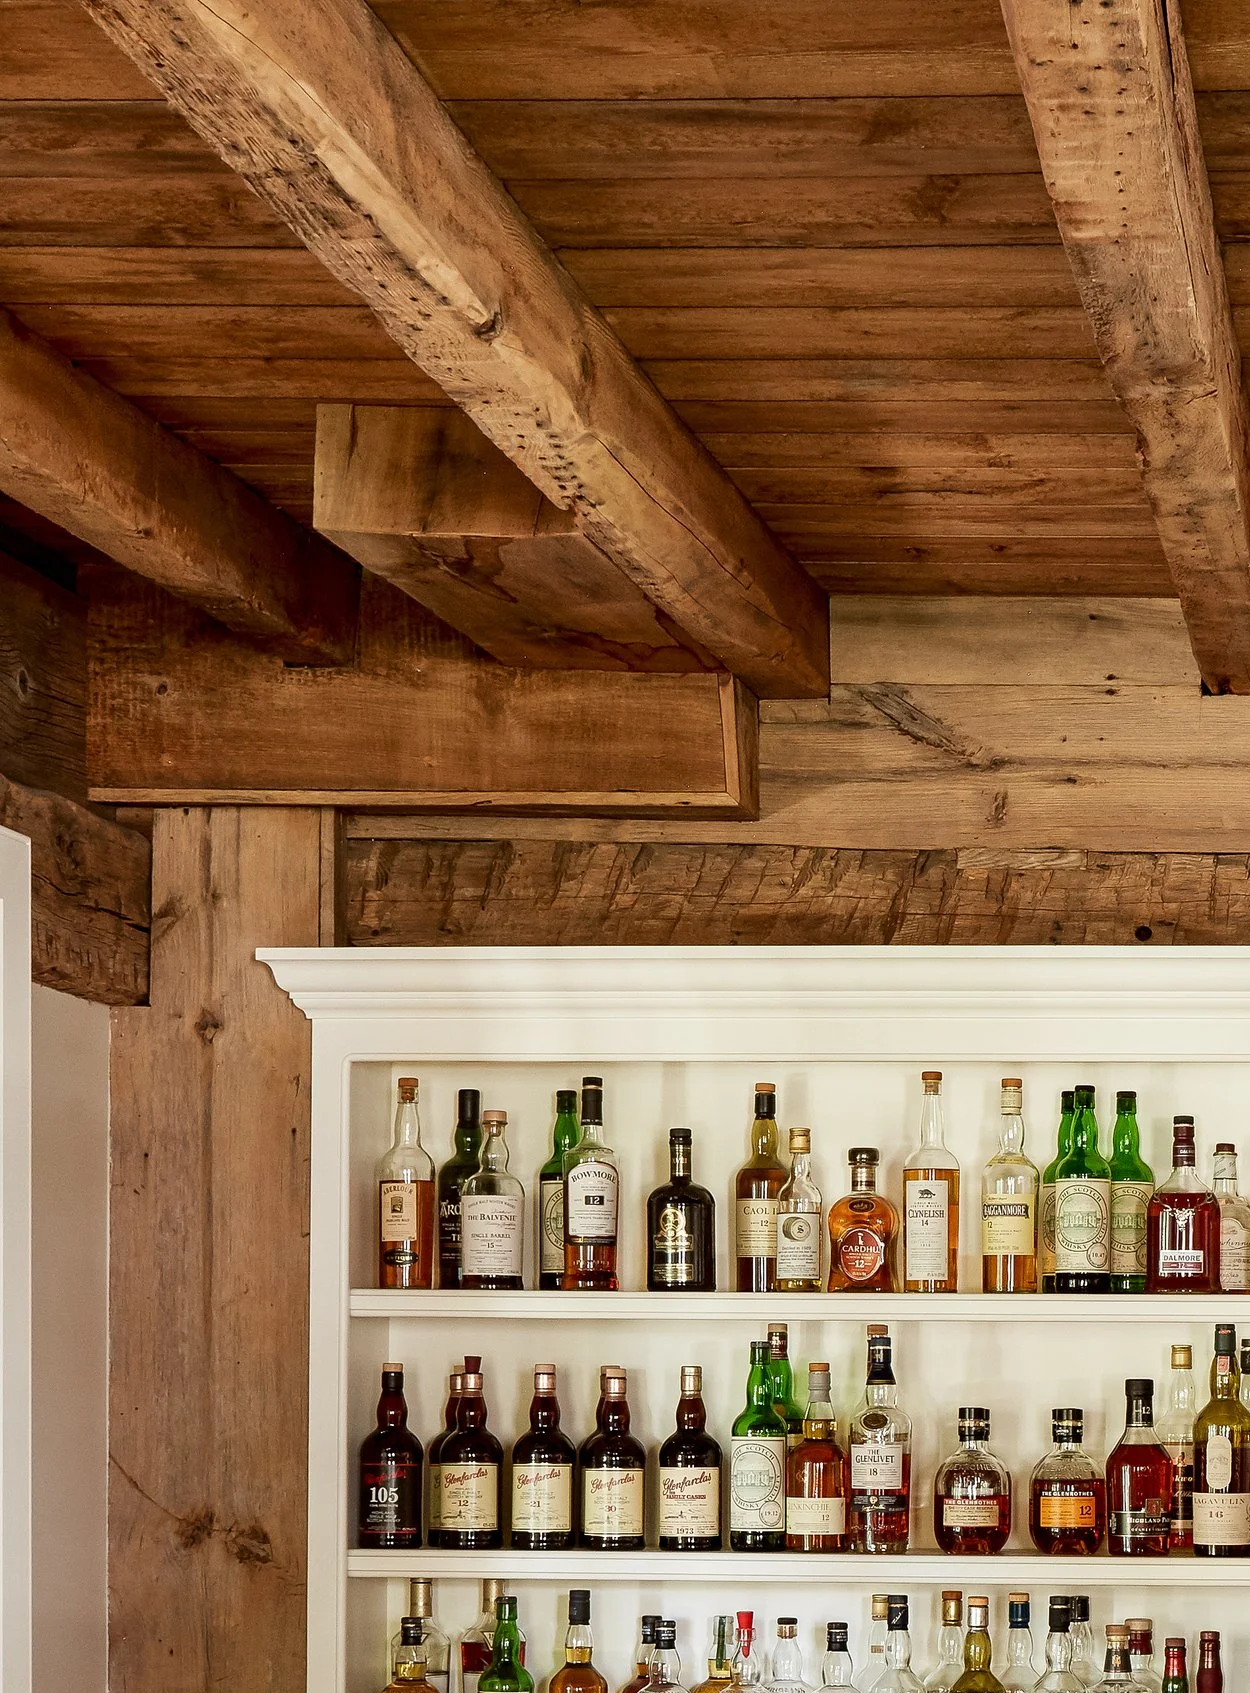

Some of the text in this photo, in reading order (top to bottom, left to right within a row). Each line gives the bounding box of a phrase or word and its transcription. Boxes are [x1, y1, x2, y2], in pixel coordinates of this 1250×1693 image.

[571, 1171, 616, 1184] BOWMORE
[383, 1184, 413, 1195] ABERLOUR
[1073, 1187, 1102, 1202] SCOTCH
[744, 1206, 770, 1215] CAOL
[908, 1209, 944, 1219] CLYNELISH
[843, 1245, 881, 1253] CARDHU
[854, 1260, 865, 1268] 12
[745, 1446, 775, 1461] SCOTCH
[856, 1455, 894, 1464] GLENLIVET
[869, 1468, 878, 1476] 18
[444, 1468, 489, 1488] Glenfarclas
[591, 1472, 635, 1494] Glenfarclas
[662, 1472, 712, 1495] Glenfarclas
[370, 1487, 398, 1502] 105
[1079, 1505, 1091, 1516] 12
[1209, 1510, 1223, 1519] 16
